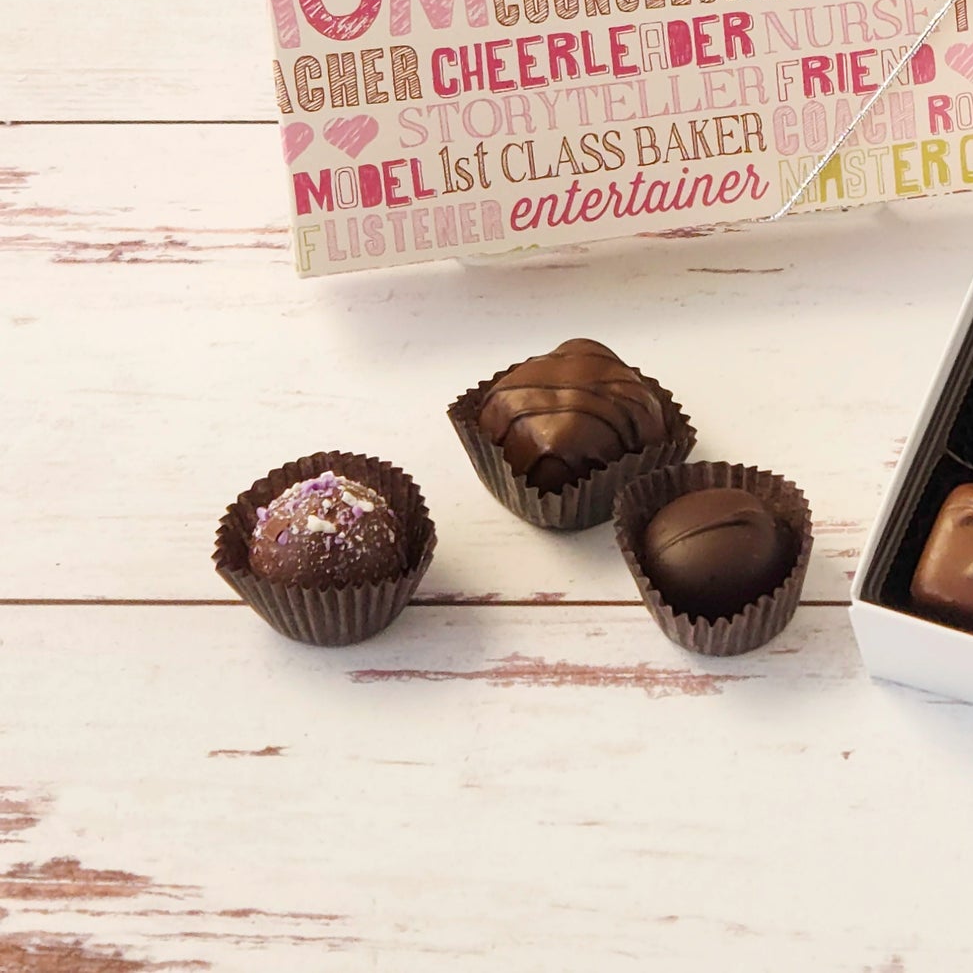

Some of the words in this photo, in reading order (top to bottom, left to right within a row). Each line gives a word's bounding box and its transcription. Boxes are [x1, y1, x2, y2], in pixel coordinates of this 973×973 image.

[400, 66, 769, 151] STORYTELLER
[777, 43, 935, 102] FRIEND
[431, 11, 754, 97] CHEERLEADER
[293, 157, 437, 215] MODEL
[439, 141, 492, 195] 1st
[501, 130, 626, 183] CLASS
[636, 112, 766, 167] BAKER
[773, 90, 917, 156] COACH
[325, 200, 505, 261] LISTENER
[510, 163, 770, 231] entertainer
[778, 138, 951, 206] MASTER
